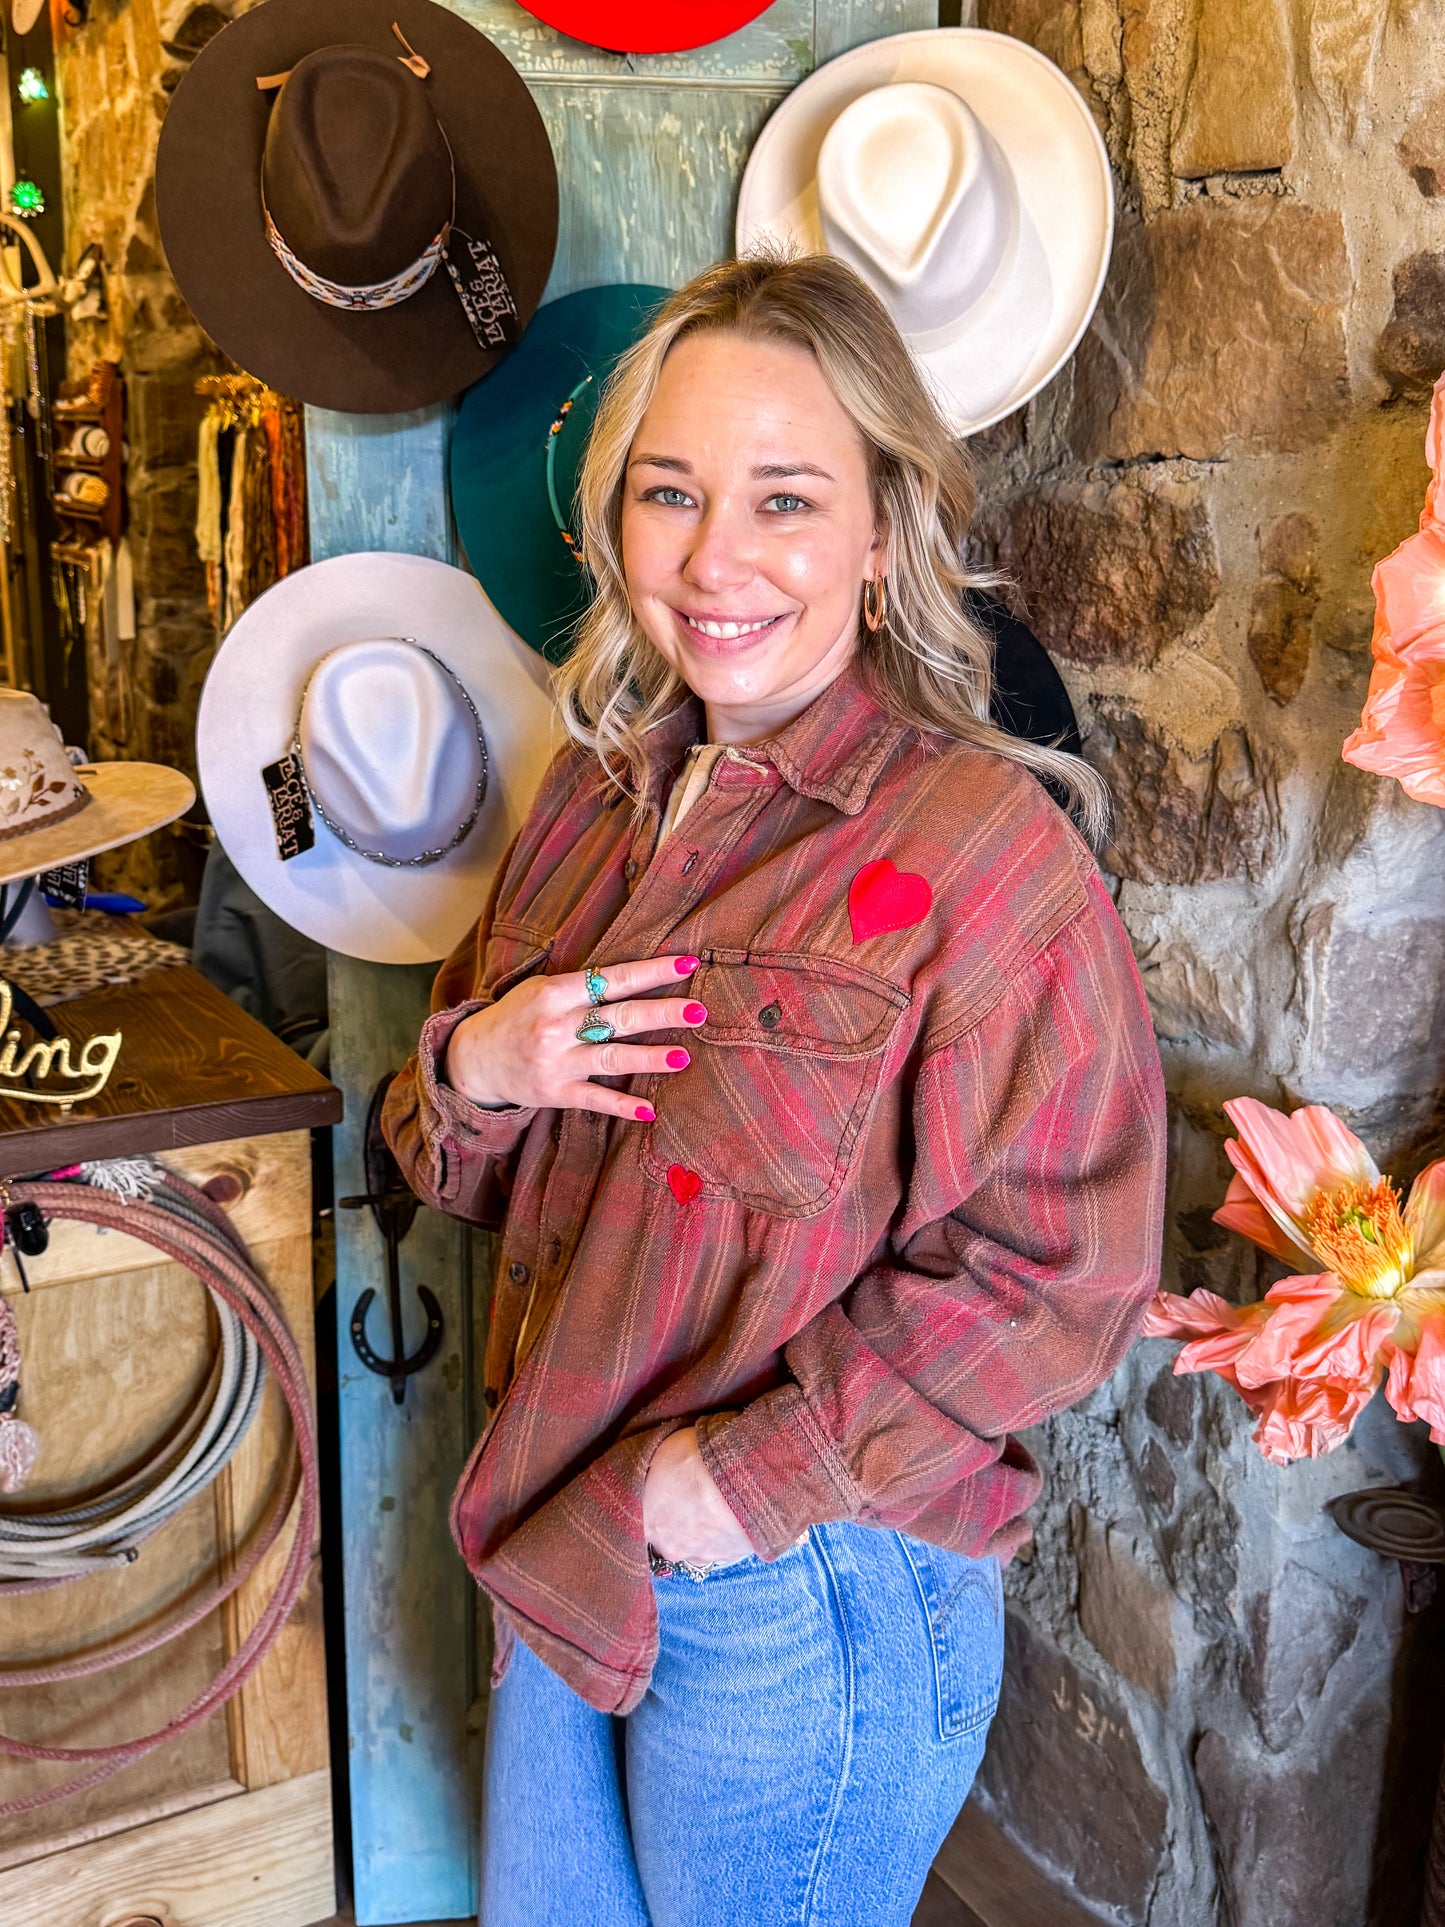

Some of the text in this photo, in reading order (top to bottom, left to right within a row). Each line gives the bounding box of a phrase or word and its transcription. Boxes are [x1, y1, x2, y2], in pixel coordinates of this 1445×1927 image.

[467, 241, 512, 317] LARIAT
[472, 293, 506, 344] LACE
[279, 760, 304, 807] LACE
[272, 785, 299, 855] LARIAT
